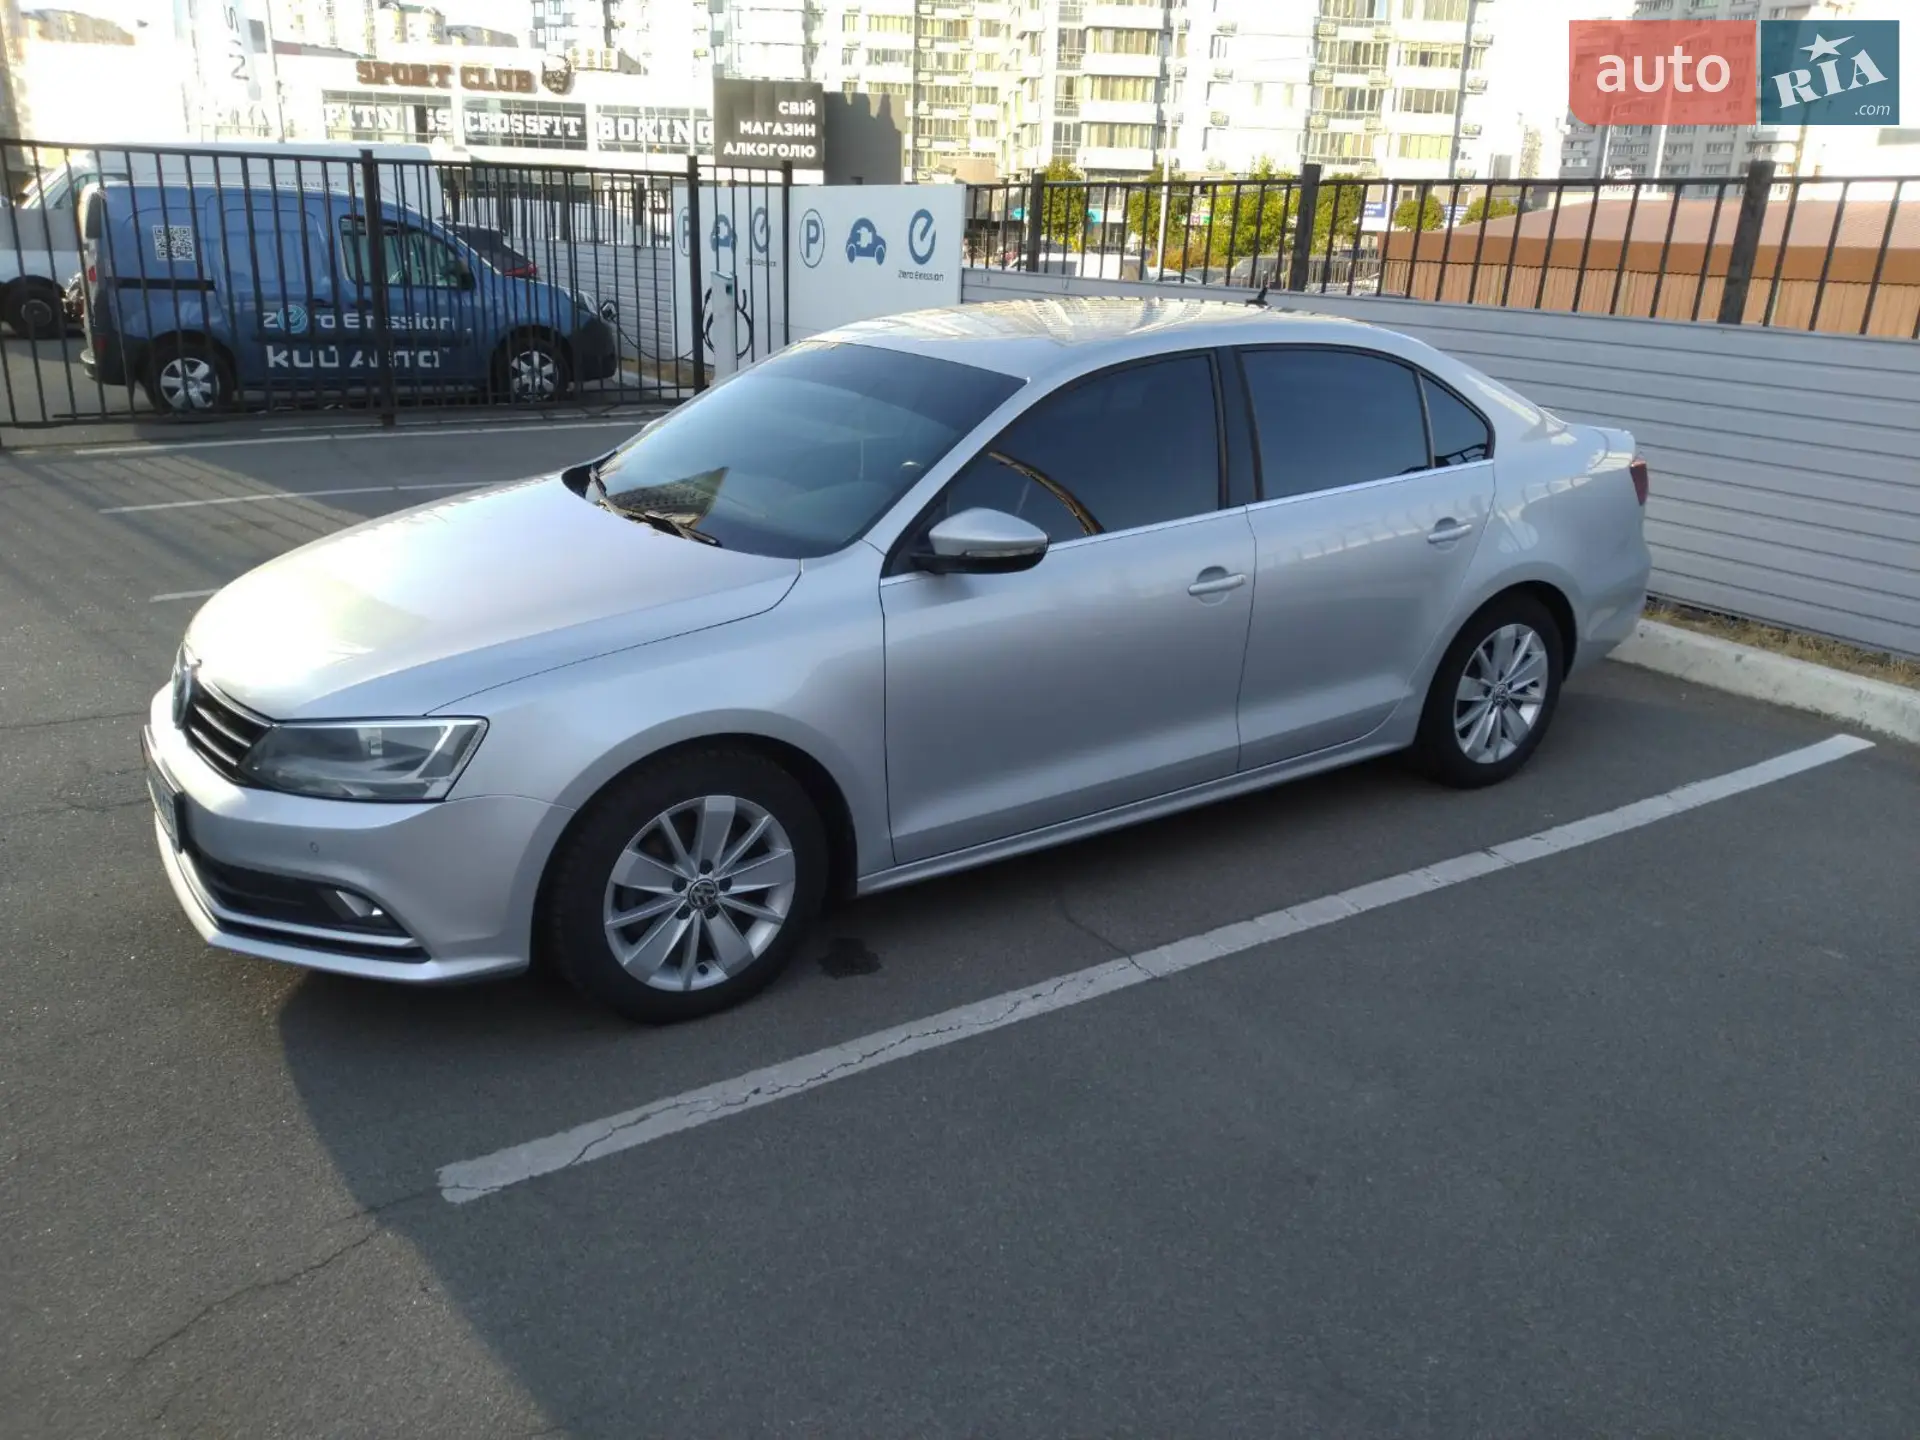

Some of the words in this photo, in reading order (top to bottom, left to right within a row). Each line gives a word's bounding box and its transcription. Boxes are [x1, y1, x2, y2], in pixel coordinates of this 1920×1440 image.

[356, 60, 454, 89] SPORT
[460, 66, 536, 93] CLUB
[779, 99, 816, 116] СВІЙ
[464, 111, 582, 137] CROSSFIT
[599, 118, 714, 144] BOXING
[739, 121, 816, 137] МАГАЗИН
[723, 142, 817, 158] АЛКОГОЛЮ
